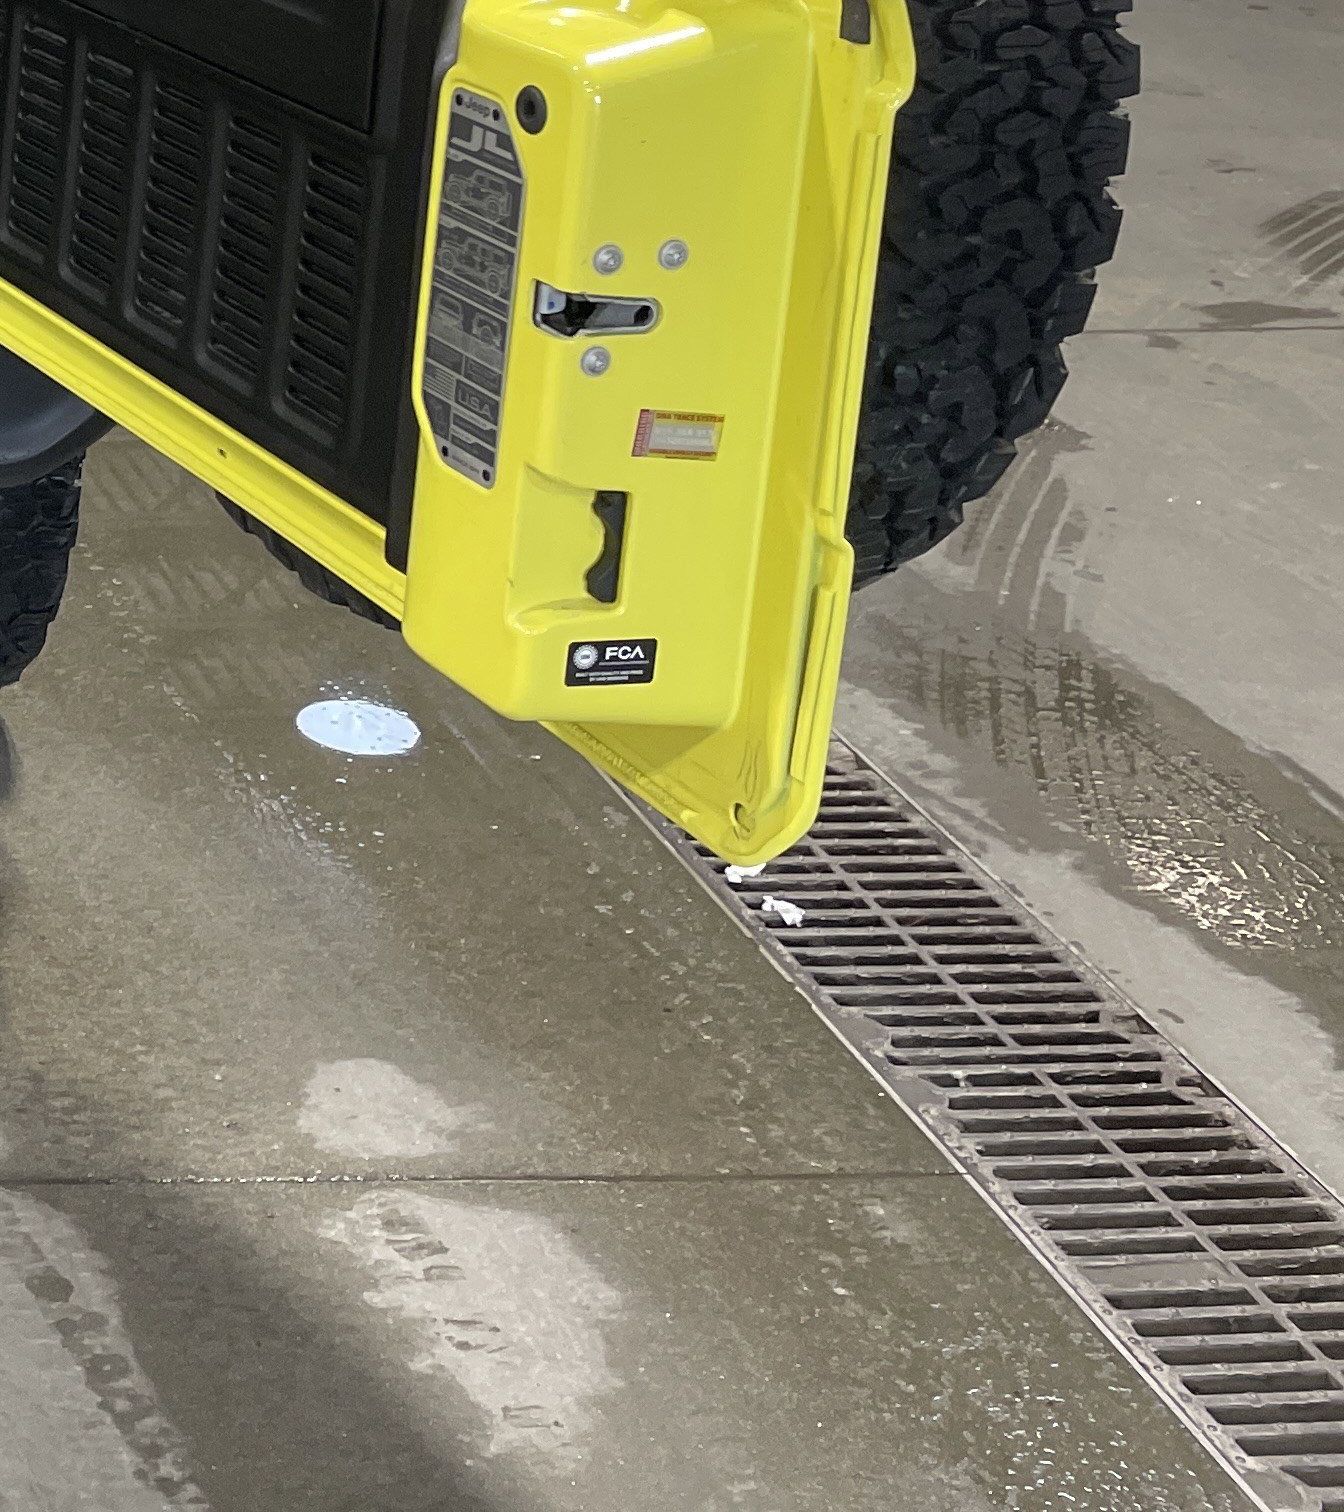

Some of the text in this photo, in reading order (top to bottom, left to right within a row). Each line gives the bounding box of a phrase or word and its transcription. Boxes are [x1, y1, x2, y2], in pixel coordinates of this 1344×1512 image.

[450, 124, 515, 162] JL
[457, 388, 493, 422] USA
[605, 645, 645, 661] FCA
